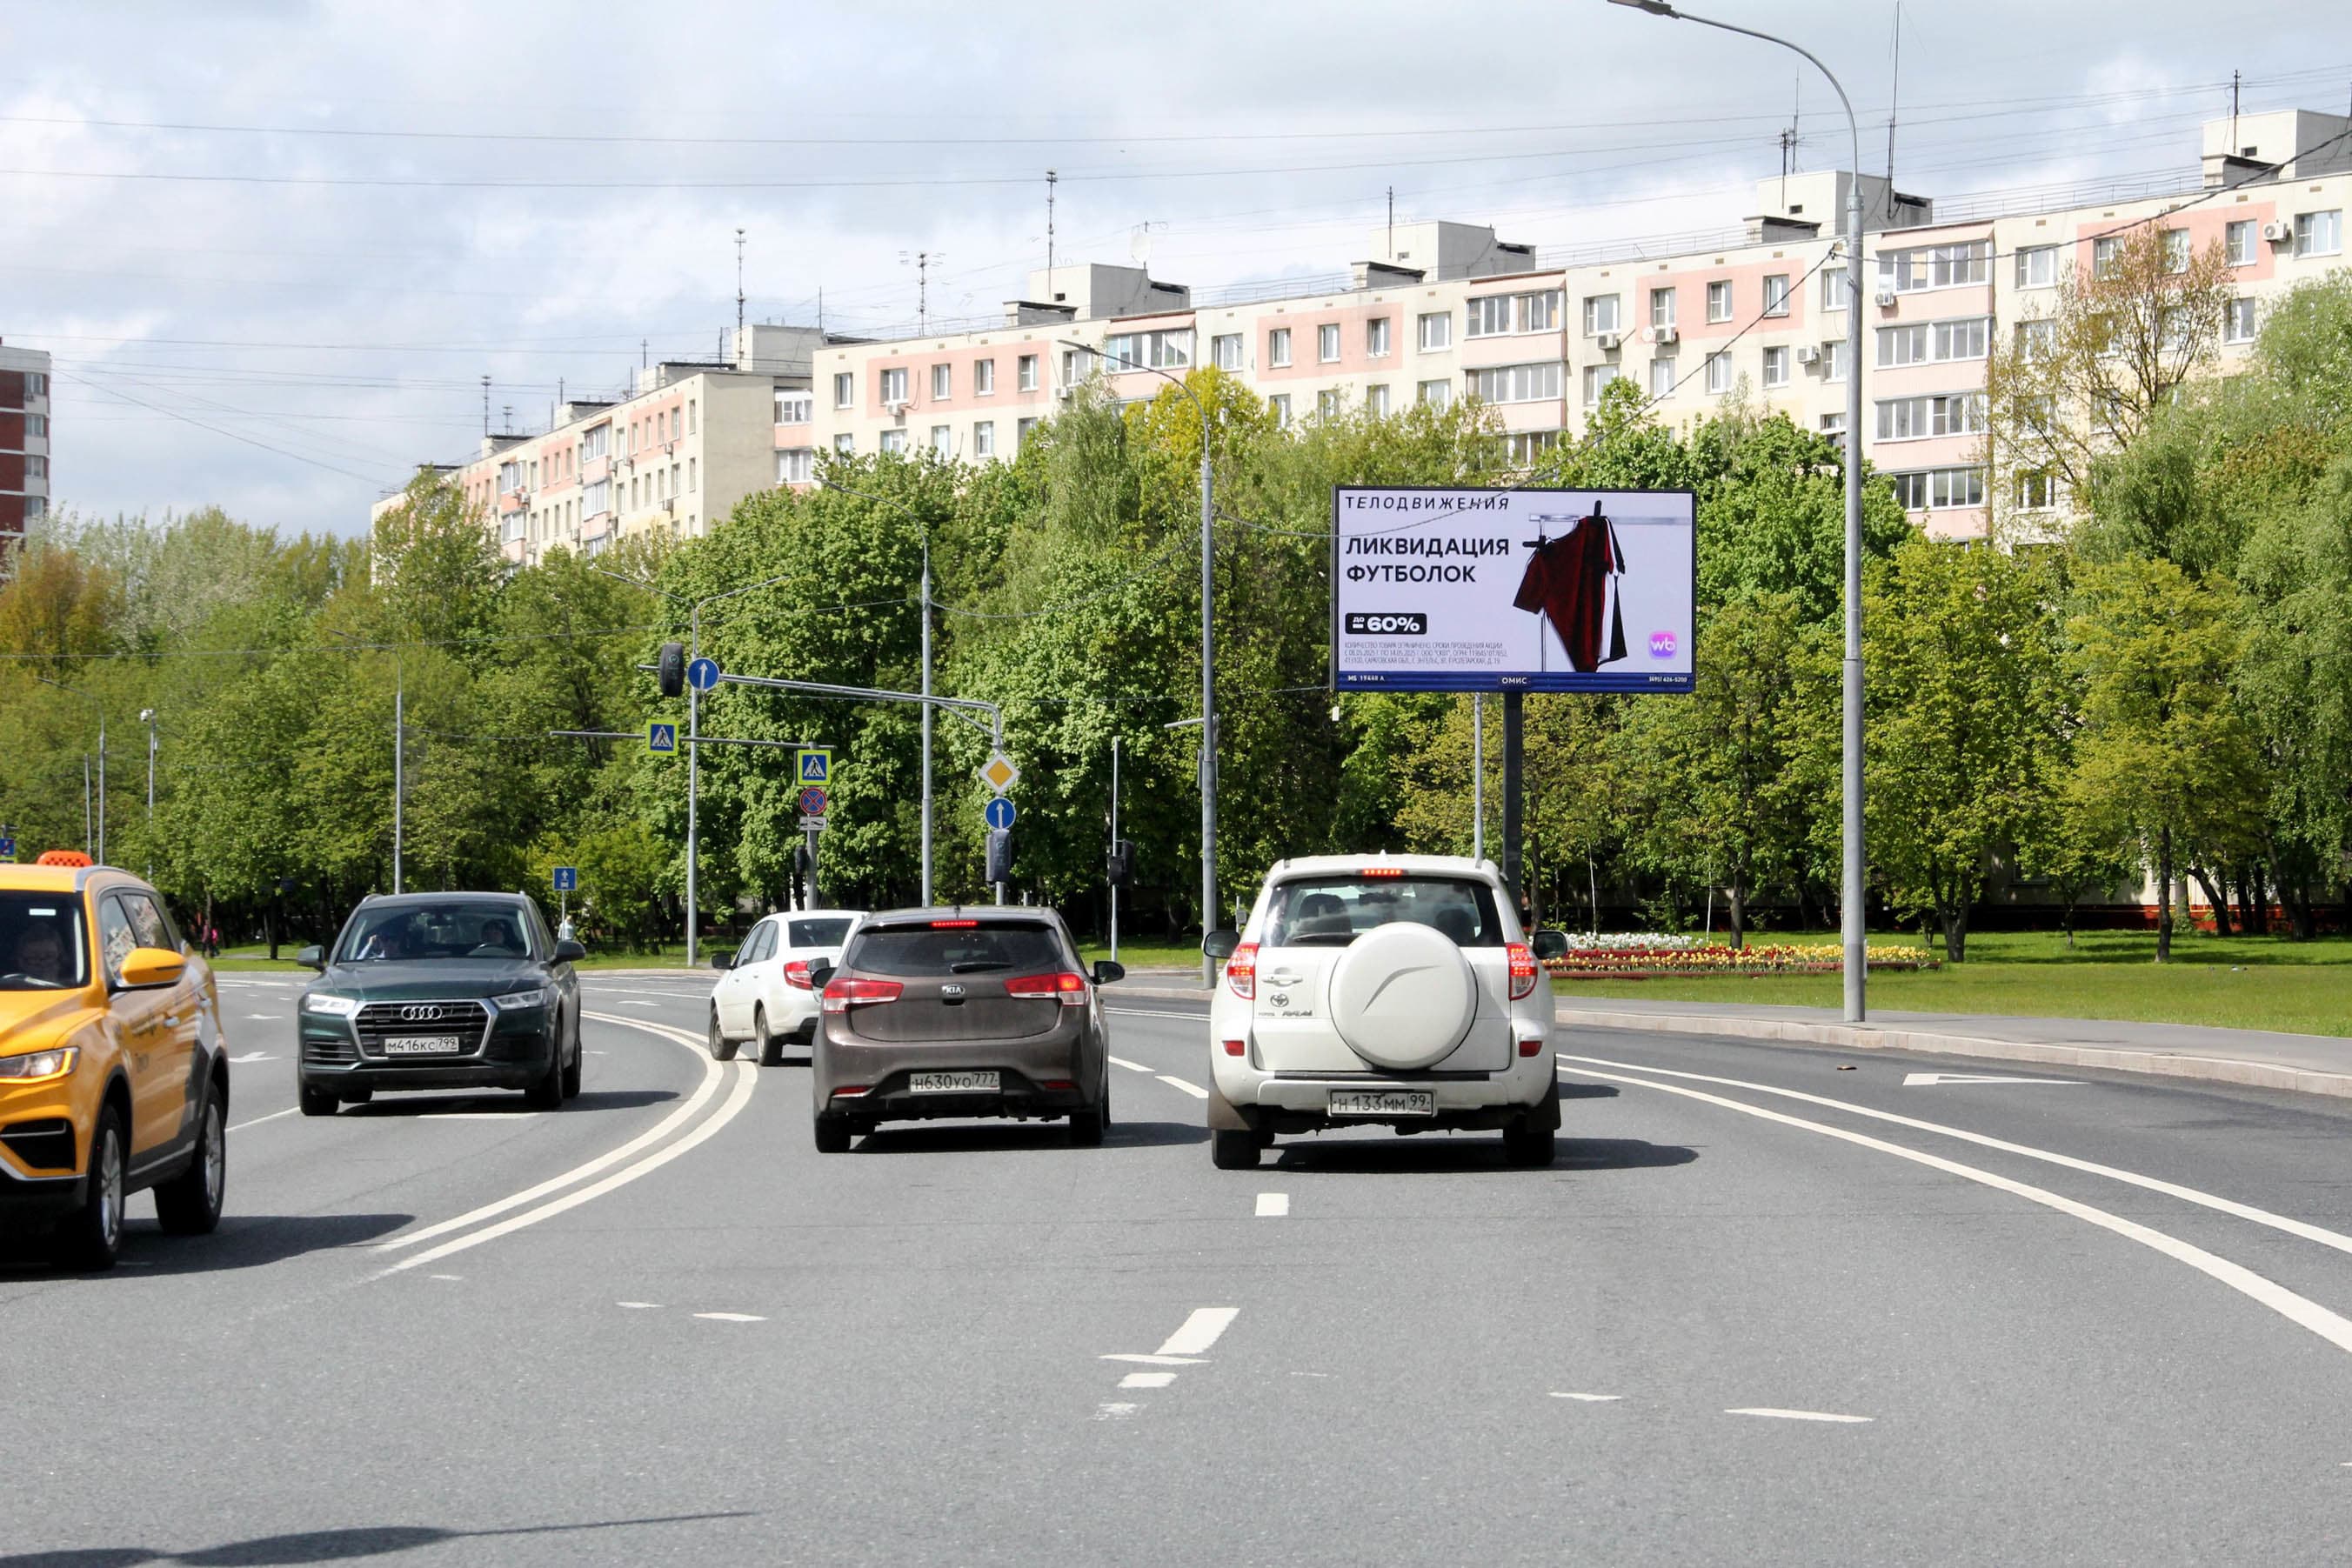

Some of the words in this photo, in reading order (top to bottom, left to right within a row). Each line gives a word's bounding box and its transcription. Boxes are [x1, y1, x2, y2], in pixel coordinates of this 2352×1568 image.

[1346, 497, 1509, 511] ТЕЛОДВИЖЕНИЯ
[1346, 537, 1510, 557] ЛИКВИДАЦИЯ
[1346, 564, 1477, 583] ФУТБОЛОК
[1650, 636, 1676, 652] wb
